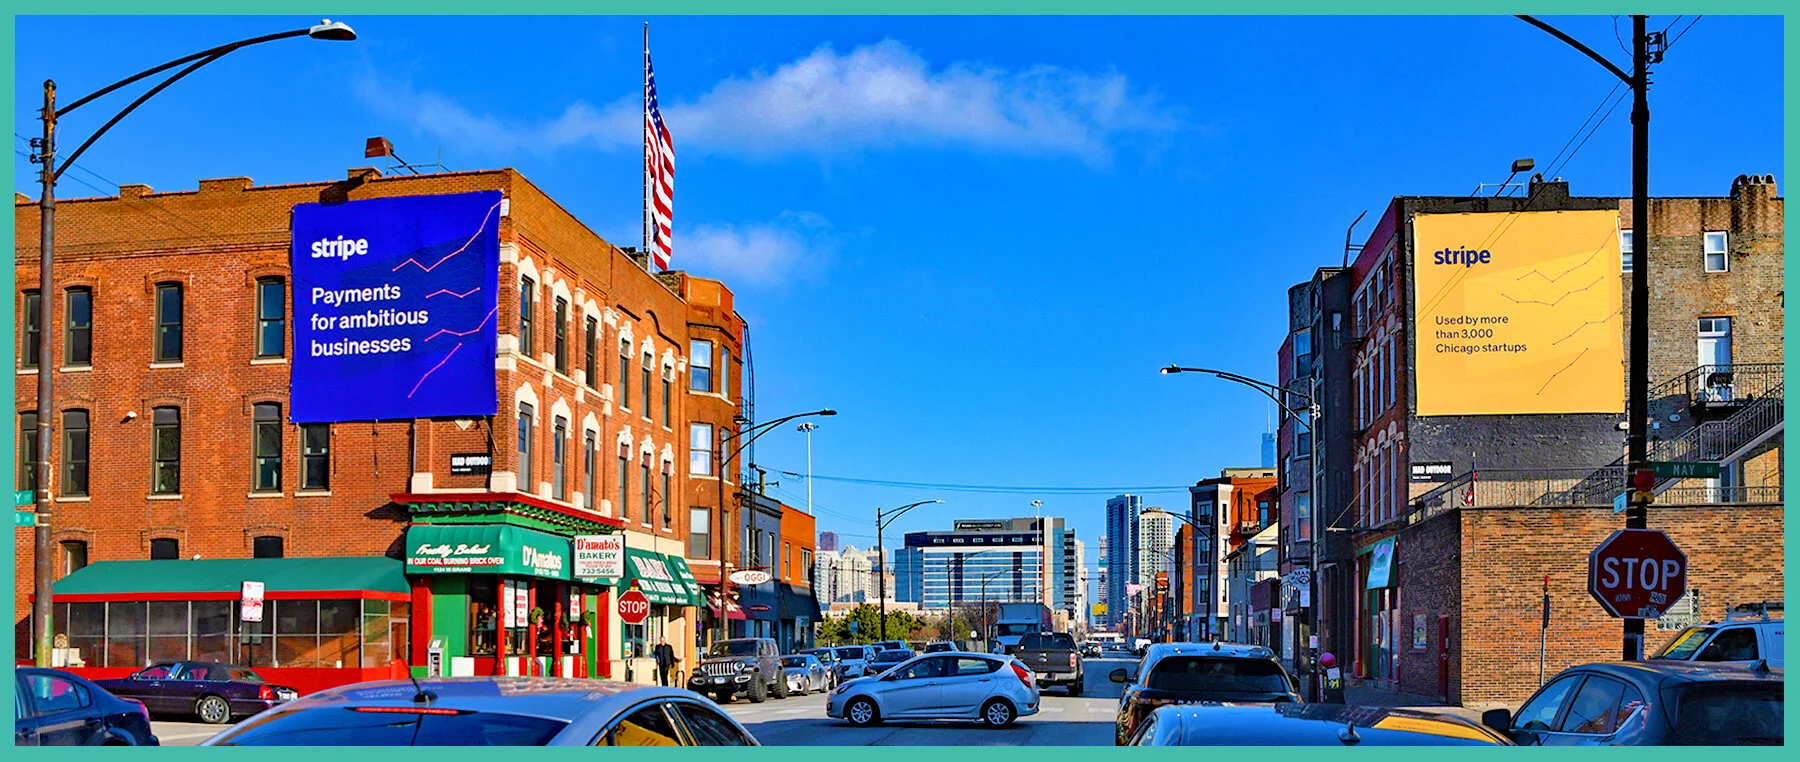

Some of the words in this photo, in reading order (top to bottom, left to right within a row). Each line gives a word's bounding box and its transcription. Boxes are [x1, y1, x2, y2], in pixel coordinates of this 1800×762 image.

[312, 235, 369, 261] stripe
[1434, 246, 1491, 268] stripe
[312, 284, 401, 307] Payments
[311, 313, 337, 330] for
[339, 308, 429, 329] ambitious
[1436, 316, 1464, 325] Used
[1466, 316, 1478, 326] by
[1436, 330, 1460, 339] than
[1462, 329, 1493, 339] 3,000
[312, 338, 411, 357] businesses
[1436, 344, 1480, 355] Chicago
[1482, 343, 1527, 353] startups
[1673, 464, 1695, 476] MAY
[470, 557, 487, 565] BRICK
[488, 557, 504, 565] OVEN
[745, 573, 766, 581] OGGI
[1602, 557, 1680, 591] STOP
[620, 600, 647, 613] STOP
